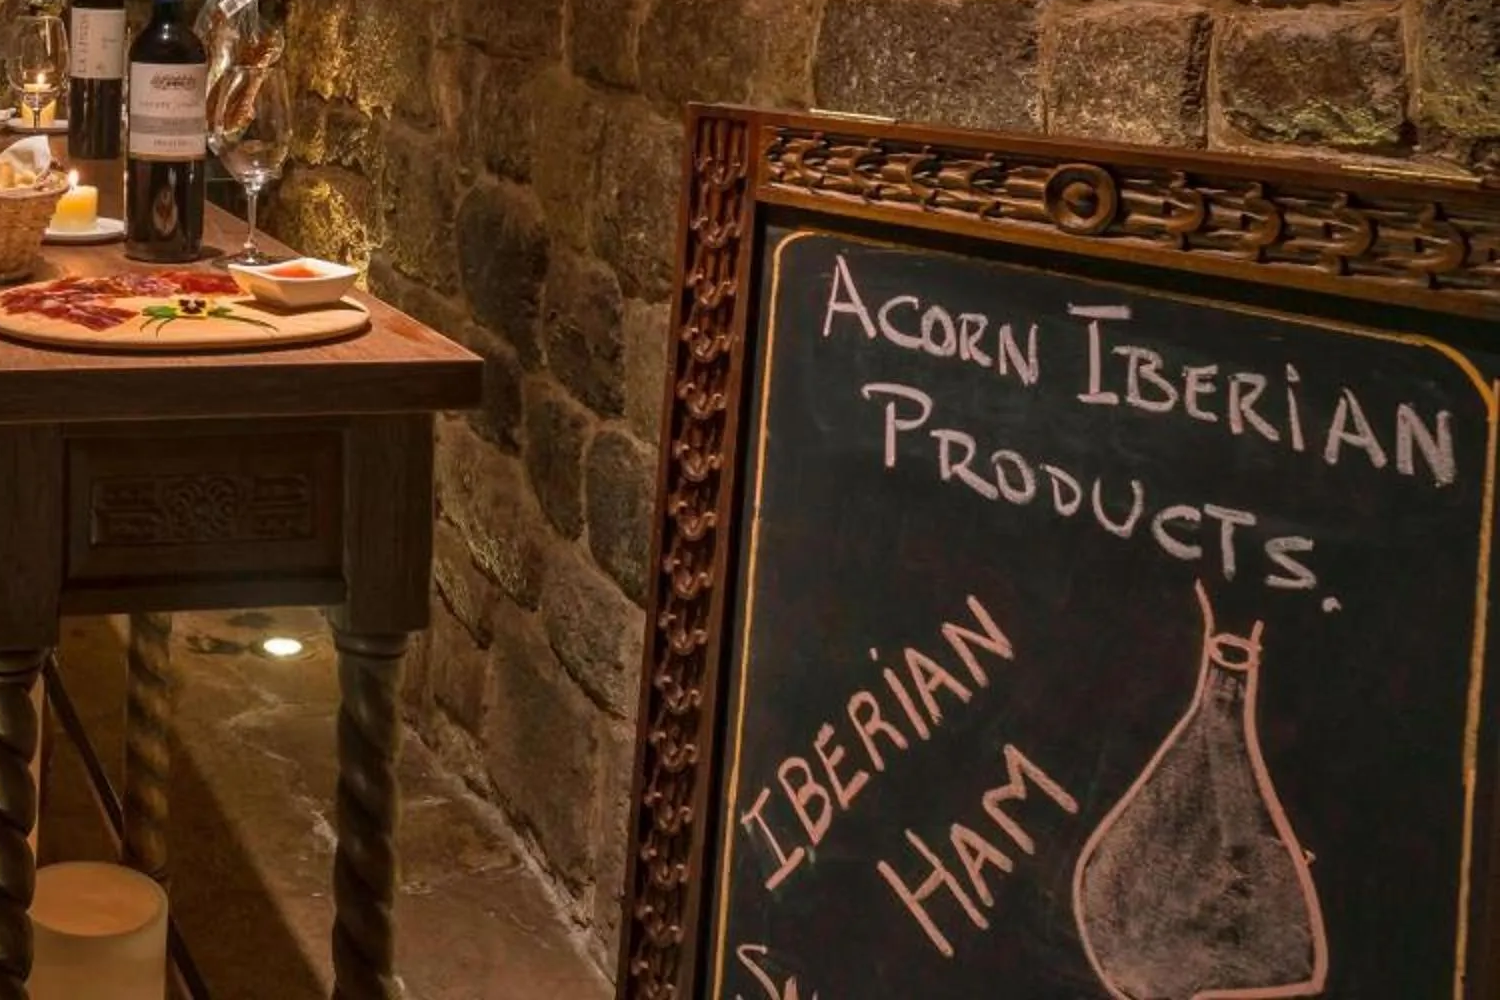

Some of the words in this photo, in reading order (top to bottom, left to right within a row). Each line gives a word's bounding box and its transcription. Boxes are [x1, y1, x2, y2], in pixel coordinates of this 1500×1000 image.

[823, 255, 1040, 384] ACORN
[1069, 304, 1454, 487] IBERIAN
[861, 383, 1342, 613] PRODUCTS.
[742, 596, 1014, 890] IBERIAN
[877, 744, 1079, 957] HAM
